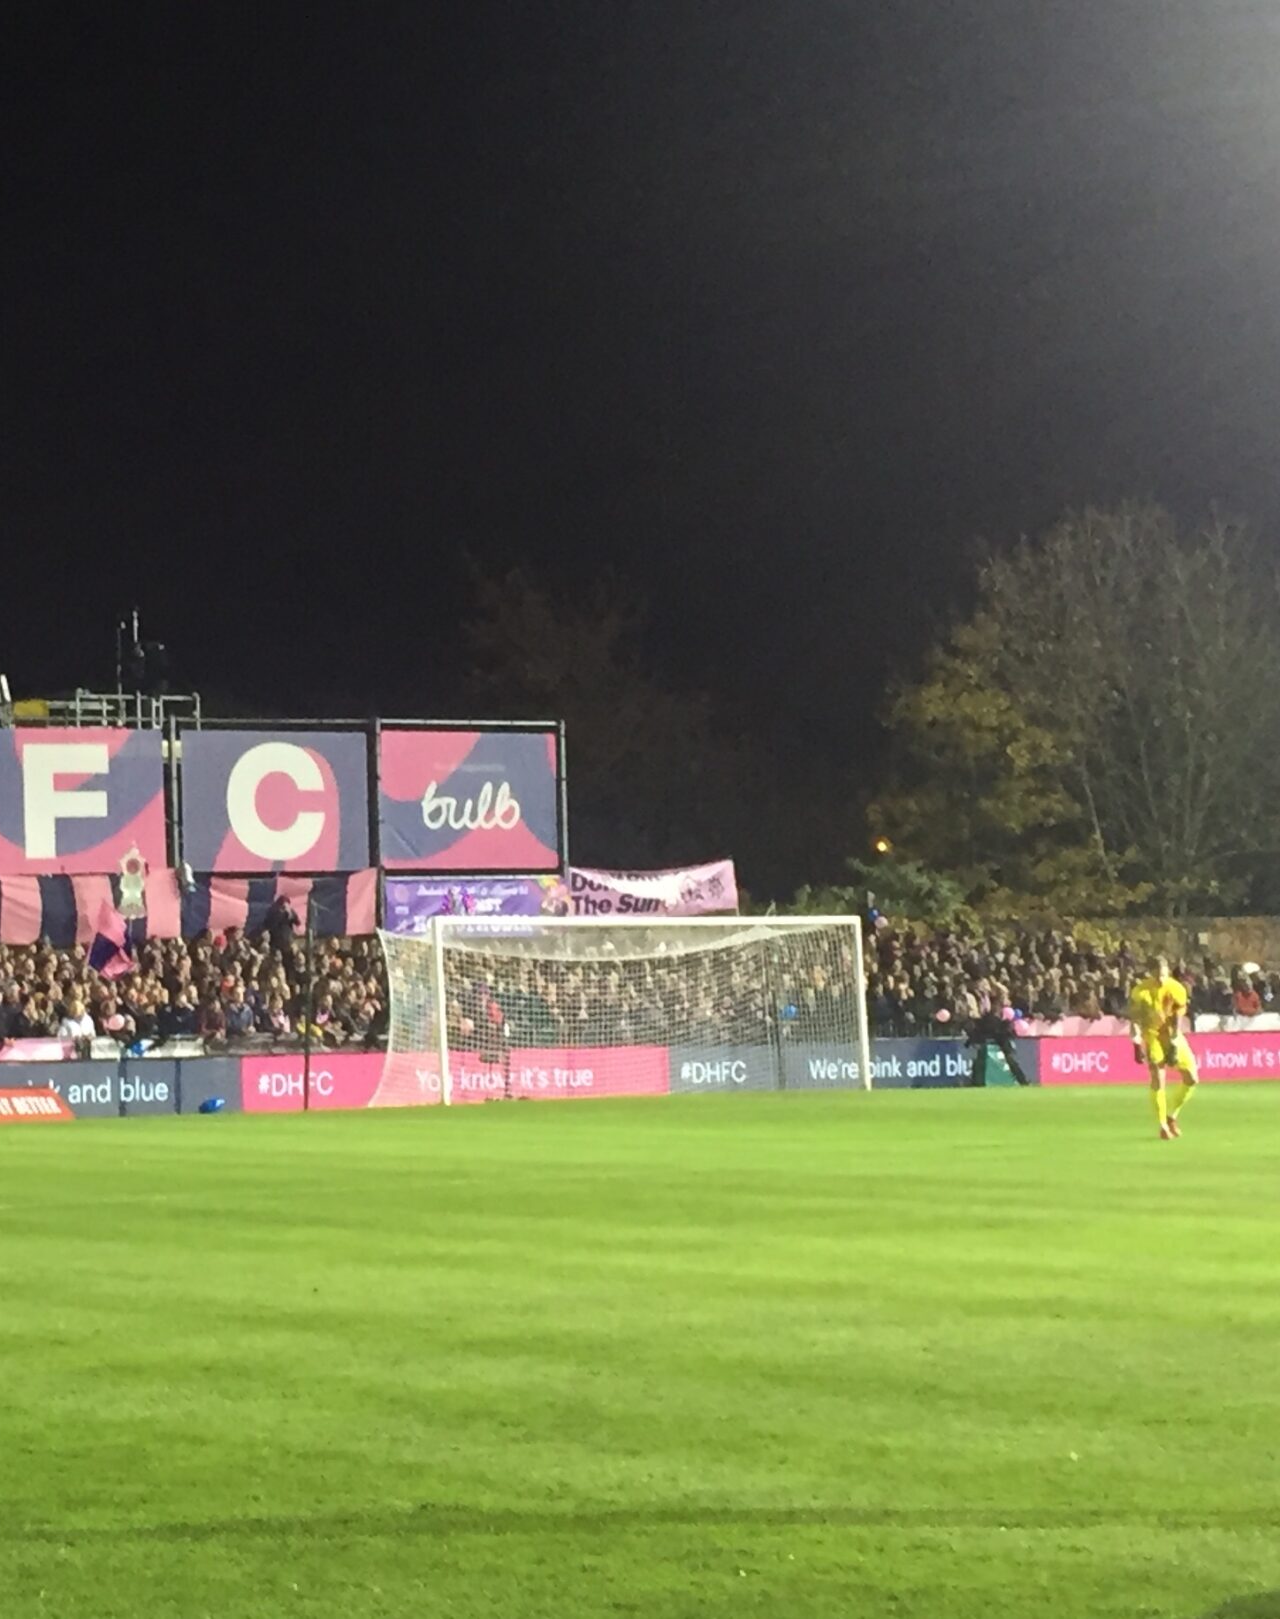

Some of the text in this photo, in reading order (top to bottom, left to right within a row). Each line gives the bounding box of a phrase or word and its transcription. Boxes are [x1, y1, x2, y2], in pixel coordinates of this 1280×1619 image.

[421, 780, 521, 831] bulb
[571, 894, 613, 915] The
[616, 893, 660, 914] Sun
[808, 1057, 859, 1079] We're
[906, 1054, 940, 1078] and
[945, 1054, 974, 1077] blu
[1051, 1051, 1109, 1073] #DHFC
[1206, 1050, 1249, 1068] know
[554, 1067, 594, 1088] true
[681, 1060, 747, 1084] #DHFC
[68, 1076, 112, 1104] and
[120, 1075, 169, 1103] blue
